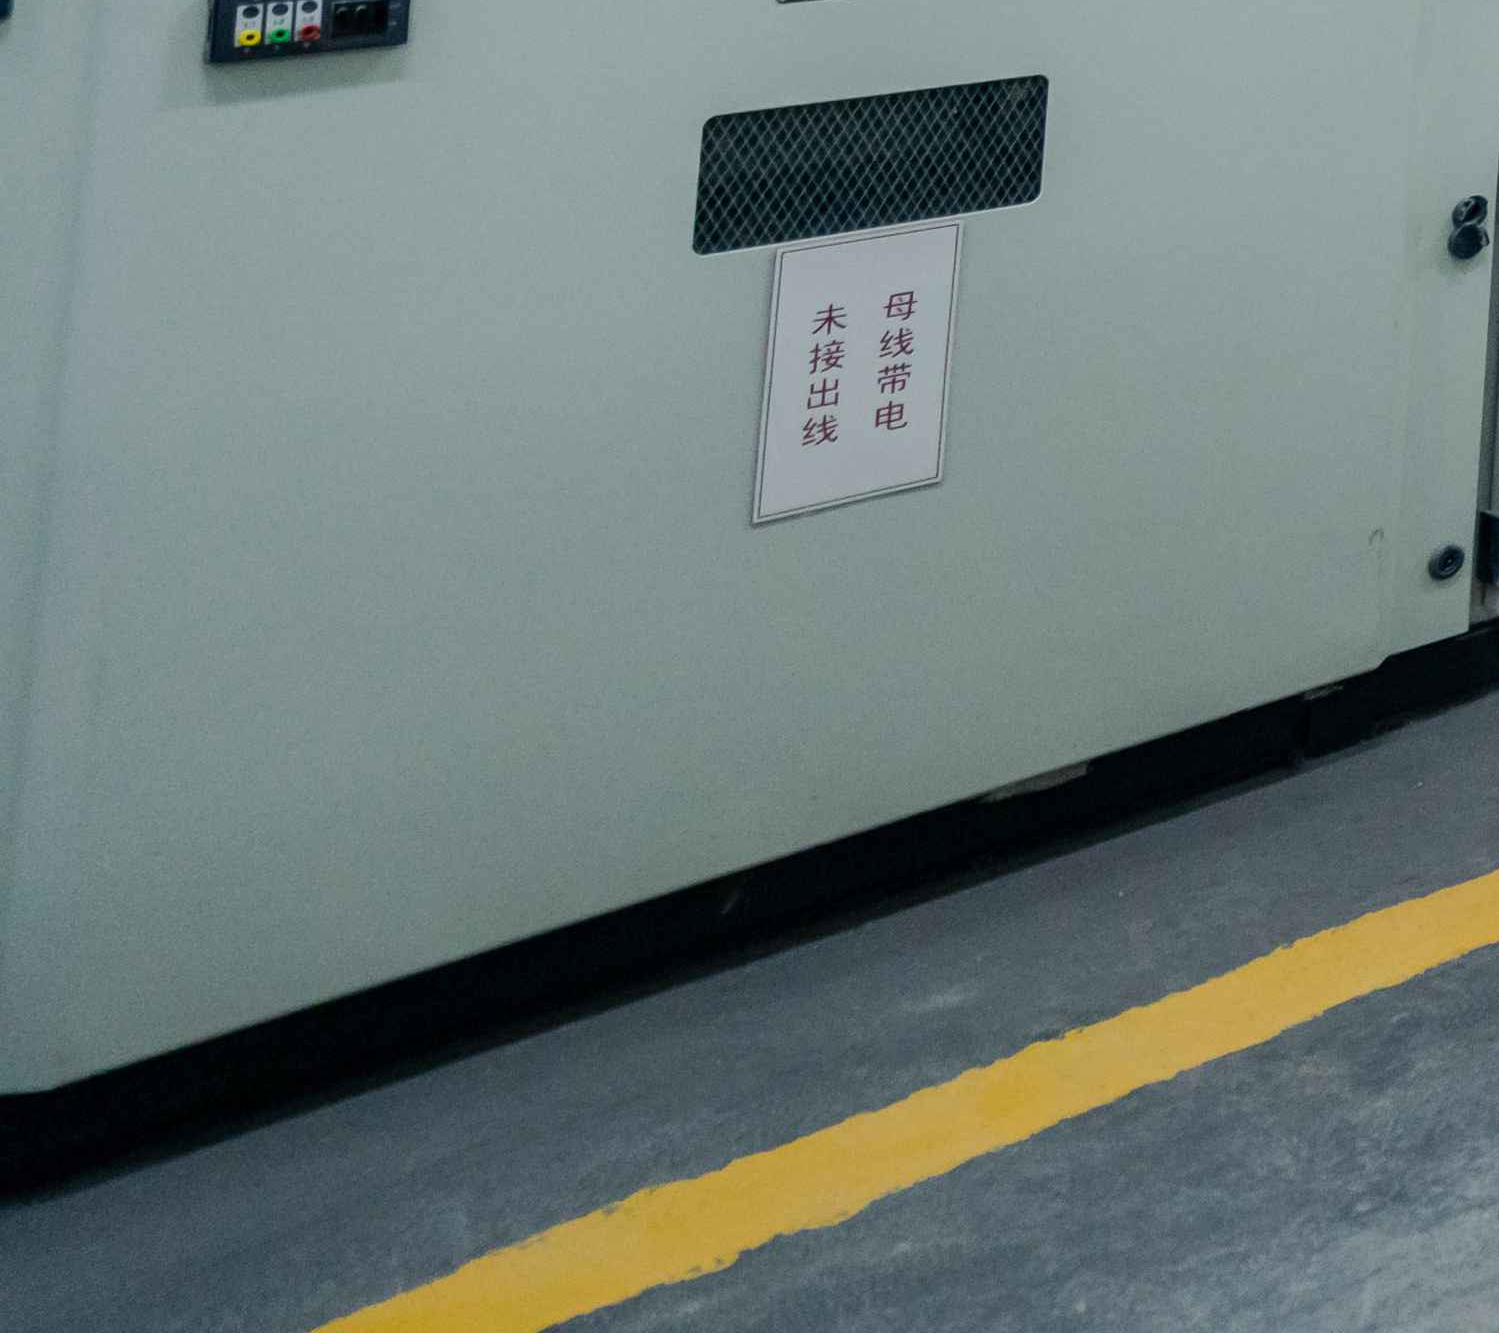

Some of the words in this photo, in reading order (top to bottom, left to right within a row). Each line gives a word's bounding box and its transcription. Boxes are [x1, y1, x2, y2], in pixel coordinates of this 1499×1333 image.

[801, 302, 849, 447] 未接出线
[874, 290, 919, 431] 母线带电
